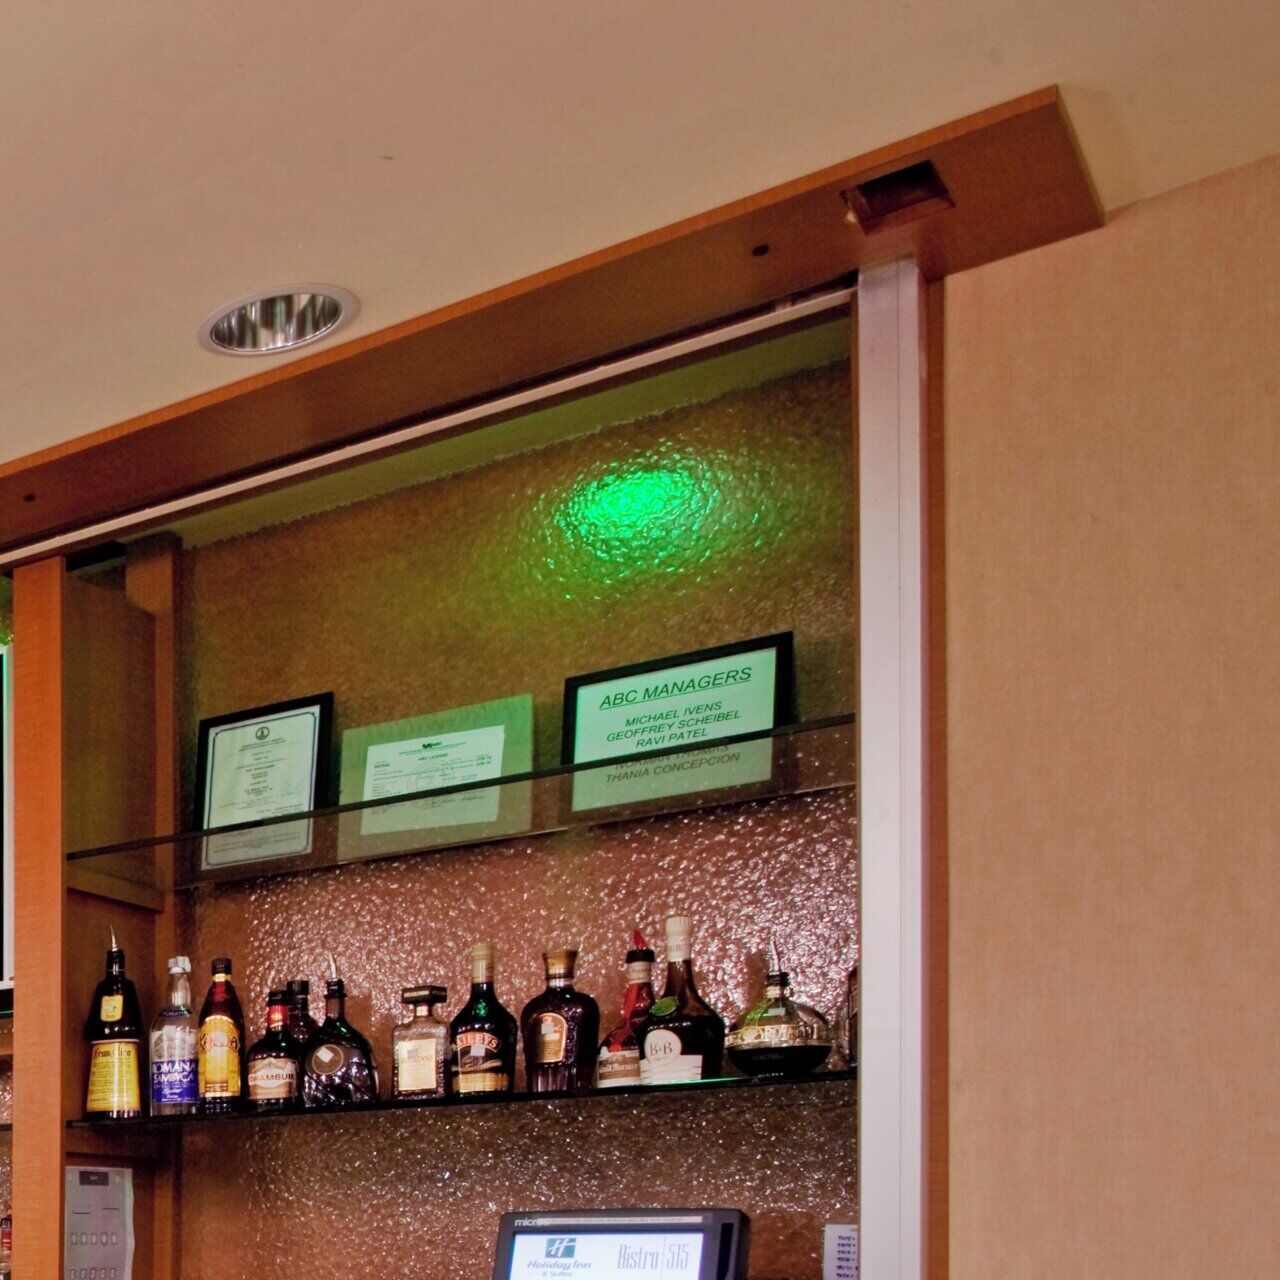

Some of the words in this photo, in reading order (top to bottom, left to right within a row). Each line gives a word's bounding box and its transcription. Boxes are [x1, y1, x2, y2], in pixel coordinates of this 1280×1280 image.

[599, 689, 638, 709] ABC
[642, 667, 753, 700] MANAGERS
[606, 722, 676, 742] GEOFFREY
[677, 710, 742, 729] SCHEIBEL
[625, 710, 680, 727] MICHAEL
[683, 701, 723, 716] IVENS
[635, 736, 666, 748] RAVI
[668, 728, 709, 744] PATEL
[606, 768, 650, 783] THANIA
[653, 752, 741, 775] CONCEPCION
[527, 1260, 571, 1271] Holiday
[572, 1259, 592, 1269] Inn
[617, 1243, 660, 1270] Bistro
[665, 1243, 690, 1270] 515
